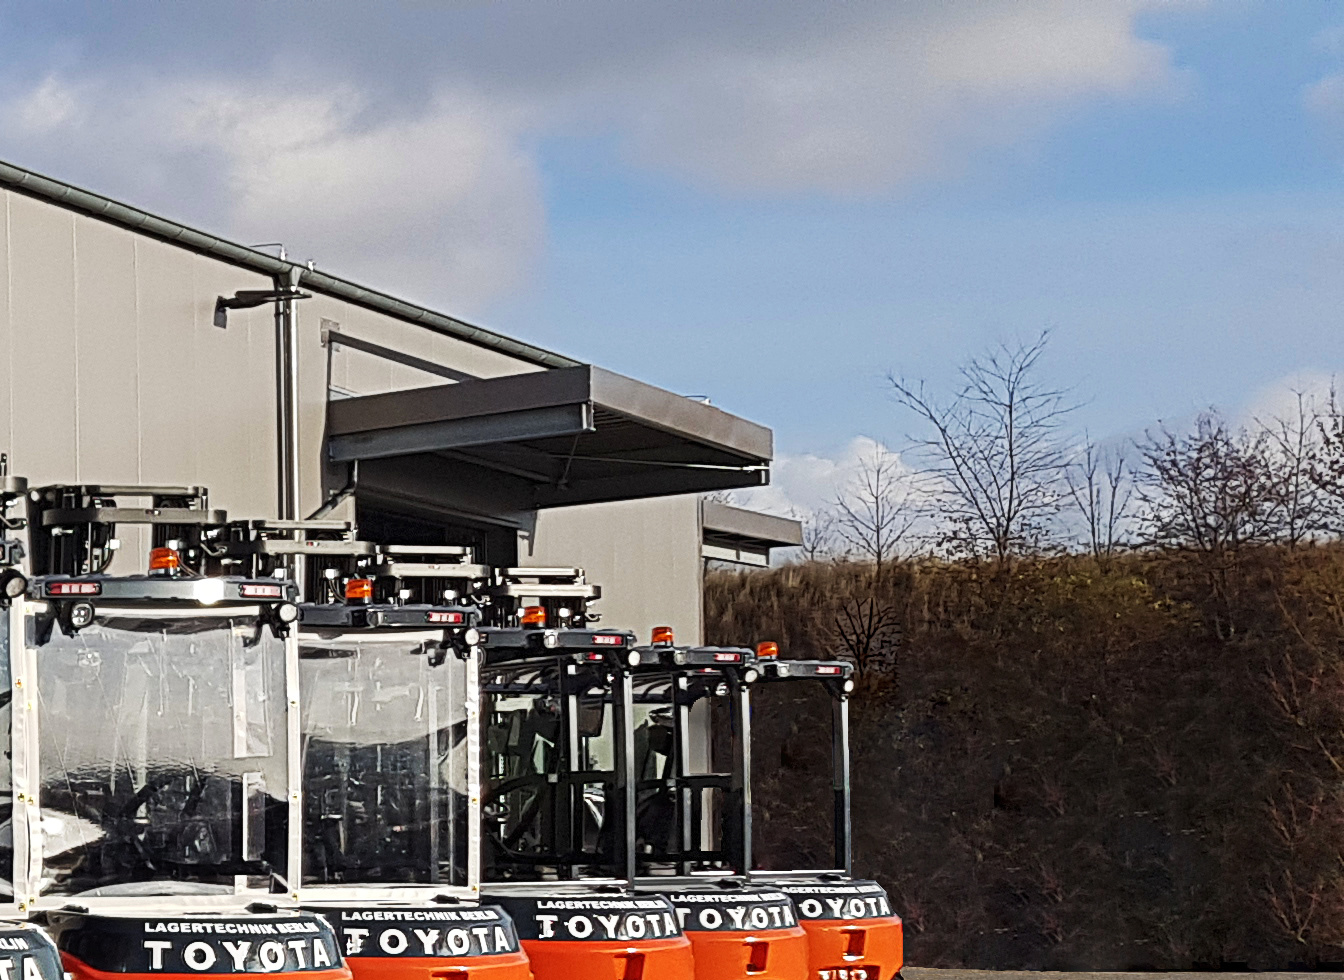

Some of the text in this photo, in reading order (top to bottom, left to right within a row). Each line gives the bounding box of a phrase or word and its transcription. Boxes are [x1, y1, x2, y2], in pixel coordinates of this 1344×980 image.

[341, 911, 461, 922] LAGERTECHNIK
[675, 905, 795, 930] TOYOTA
[801, 896, 891, 919] OYOTA
[144, 921, 321, 935] LAGERTECHNIK BERLIN
[535, 912, 678, 939] TOYOTA
[343, 926, 512, 956] TOYOTA
[143, 938, 332, 972] TOYOTA
